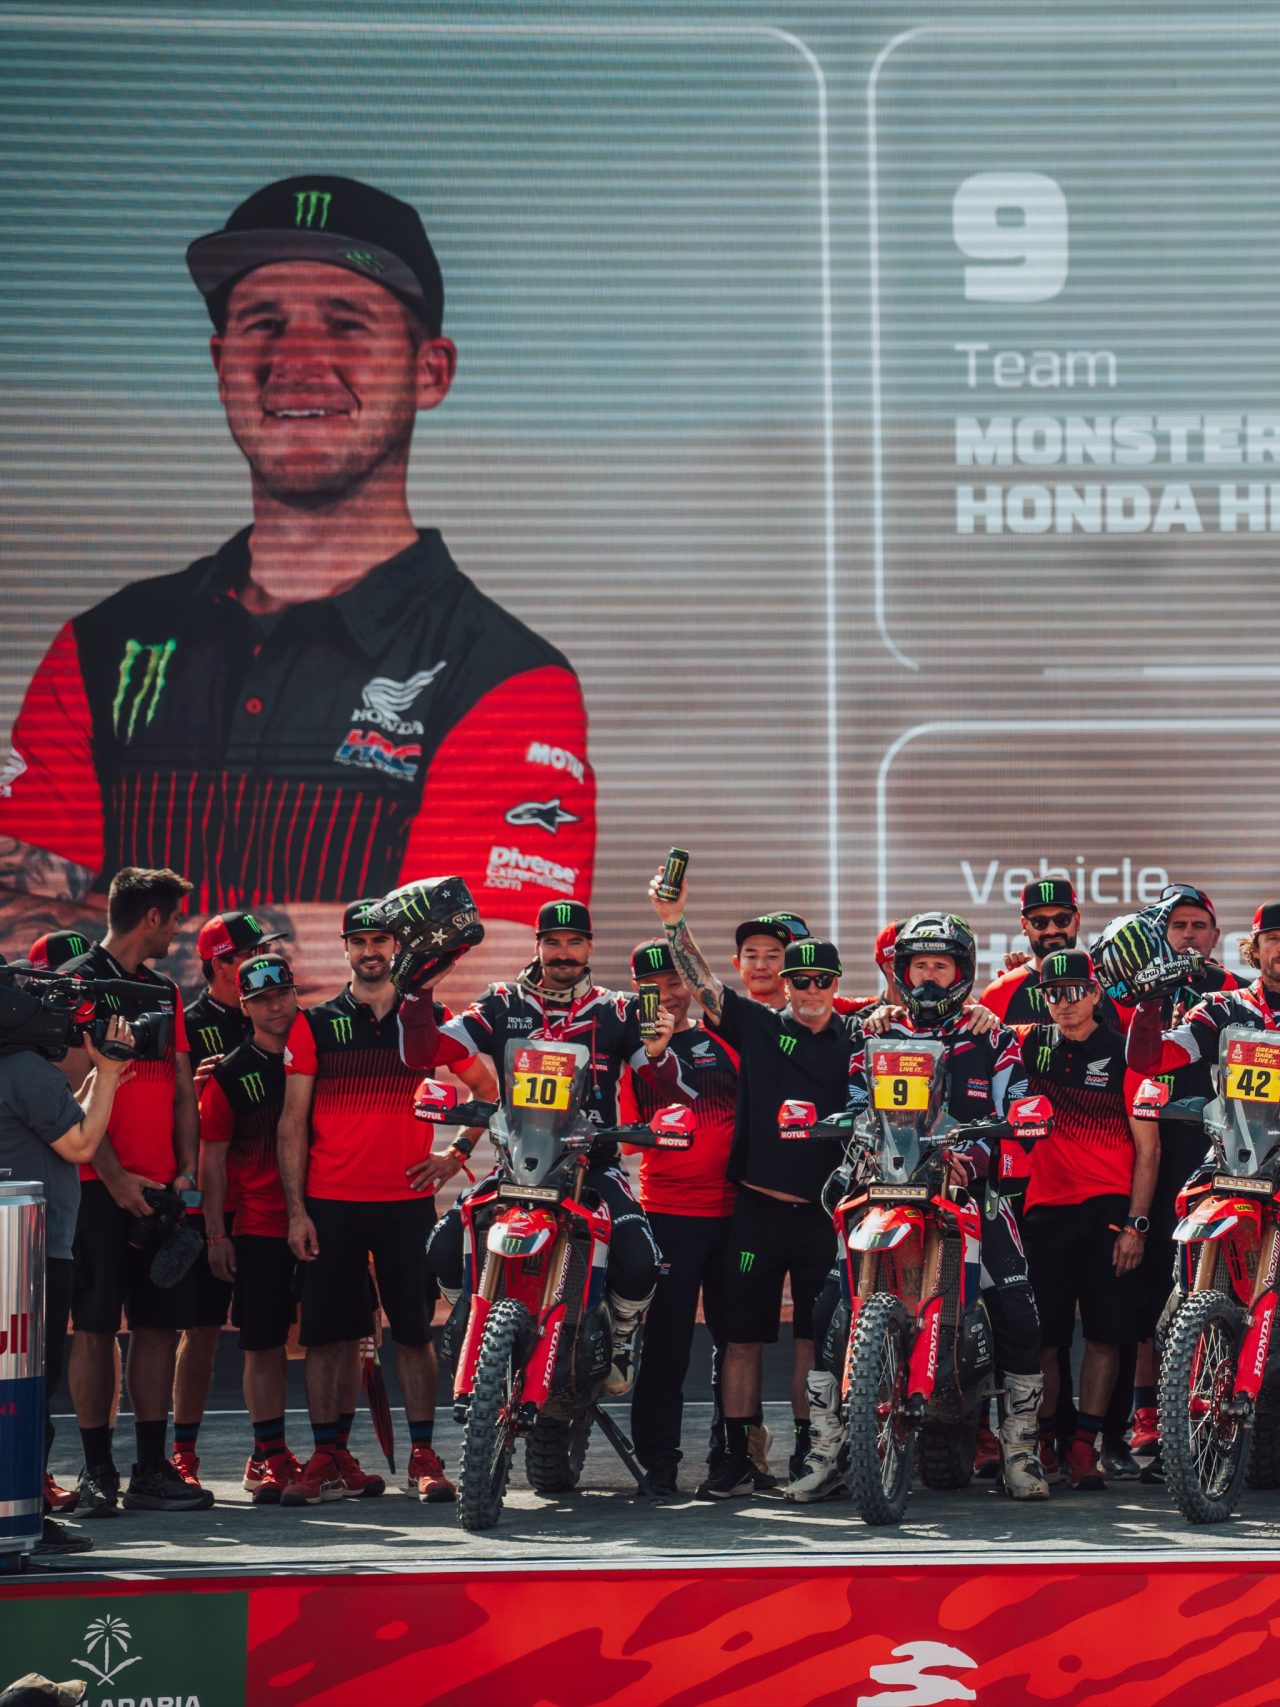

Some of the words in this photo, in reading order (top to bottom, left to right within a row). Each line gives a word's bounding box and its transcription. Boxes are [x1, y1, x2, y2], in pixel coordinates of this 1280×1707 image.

[952, 171, 1068, 301] 9
[954, 342, 1117, 388] Team
[956, 484, 1205, 534] HONDA
[351, 708, 425, 735] HONDA
[336, 729, 422, 775] HRC
[525, 741, 587, 785] MOTUL
[489, 845, 577, 884] Diverse
[1137, 968, 1159, 982] Arai
[1256, 1046, 1280, 1055] DREAM.
[525, 1077, 557, 1106] 10
[893, 1079, 908, 1105] 9
[967, 1089, 988, 1098] MOTUL
[1236, 1068, 1271, 1098] 42
[414, 1110, 442, 1120] MOTUL
[1132, 1107, 1157, 1117] MOTUL
[658, 1138, 689, 1147] MOTUL
[780, 1130, 808, 1138] MOTUL
[1016, 1127, 1046, 1136] MOTUL
[543, 1321, 562, 1388] HONDA
[926, 1312, 940, 1380] HONDA
[1254, 1309, 1272, 1378] HONDA
